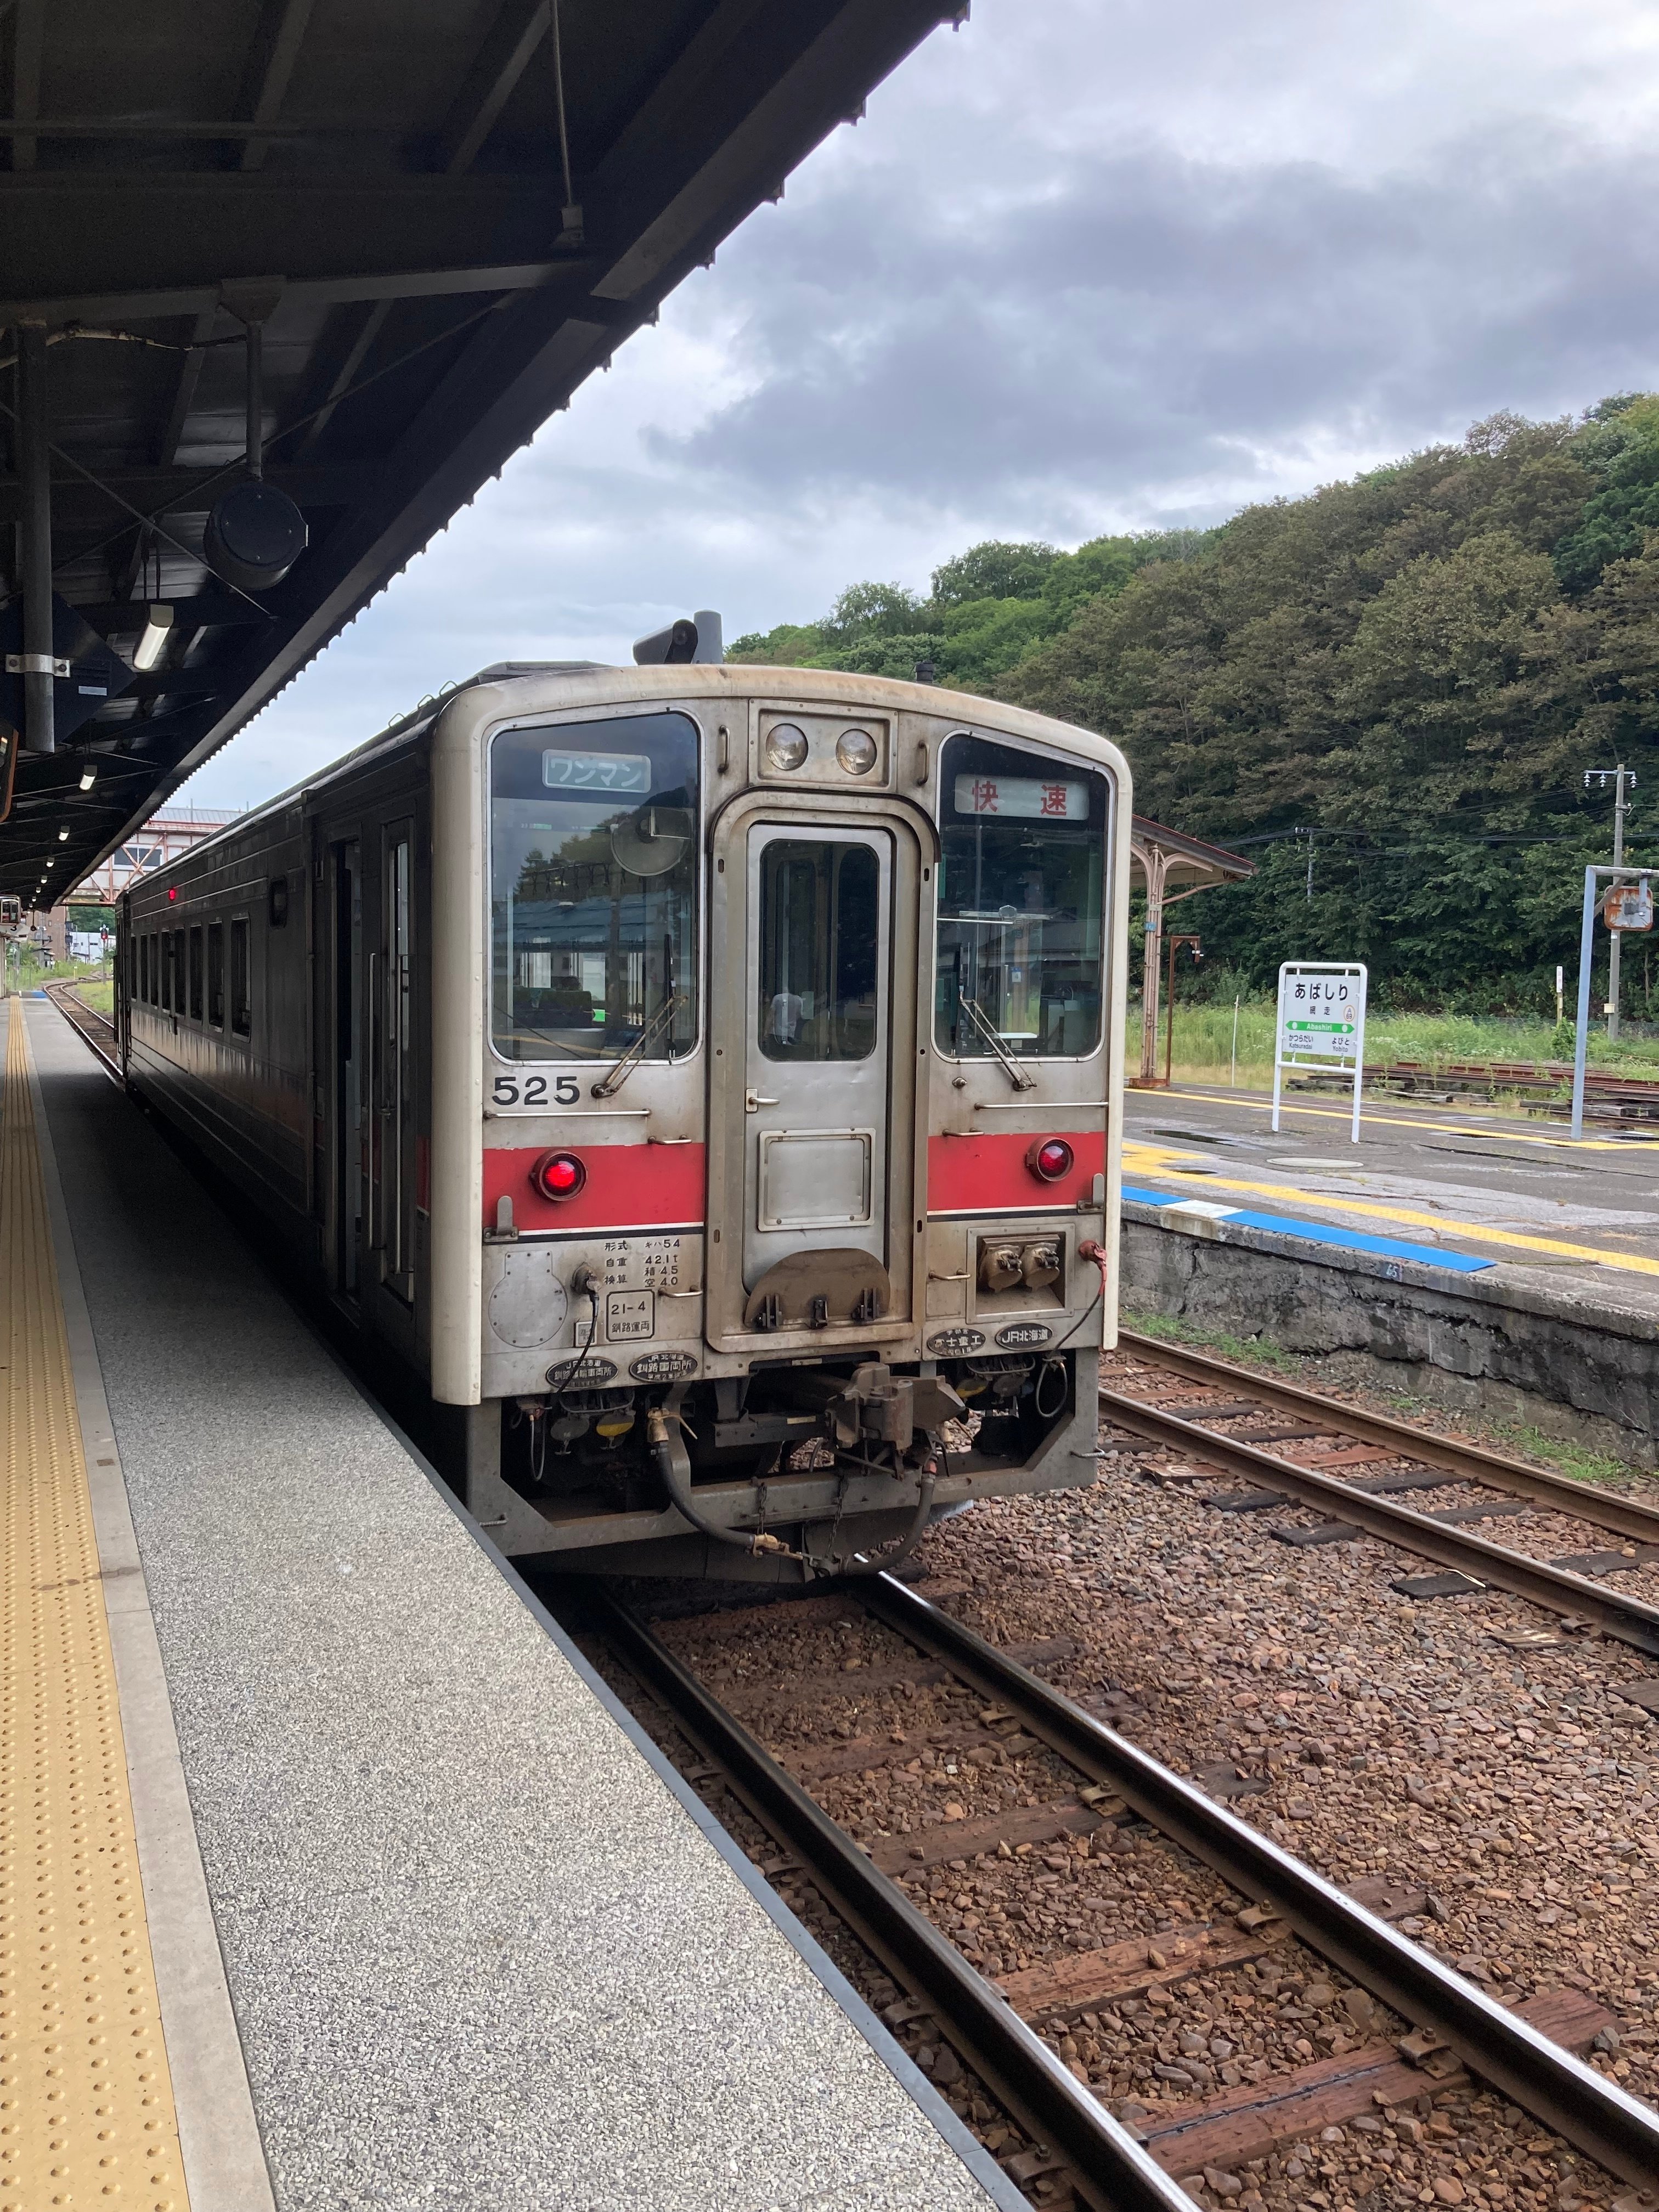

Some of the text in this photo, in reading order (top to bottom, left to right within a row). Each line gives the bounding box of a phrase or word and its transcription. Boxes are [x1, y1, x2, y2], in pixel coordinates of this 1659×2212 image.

[550, 758, 641, 787] ワンマン
[972, 780, 1066, 816] 快速
[1295, 983, 1348, 1001] あばしり
[1306, 1023, 1332, 1031] Abashiri
[1331, 1037, 1350, 1046] よびと
[492, 1076, 580, 1105] 525
[605, 1239, 680, 1251] 形式 キハ54
[606, 1257, 628, 1267] 自重
[660, 1265, 678, 1275] 4.5
[604, 1274, 628, 1285] 換算
[660, 1277, 678, 1286] 4.0
[611, 1301, 646, 1314] 21-4
[1002, 1329, 1048, 1344] JR北海道
